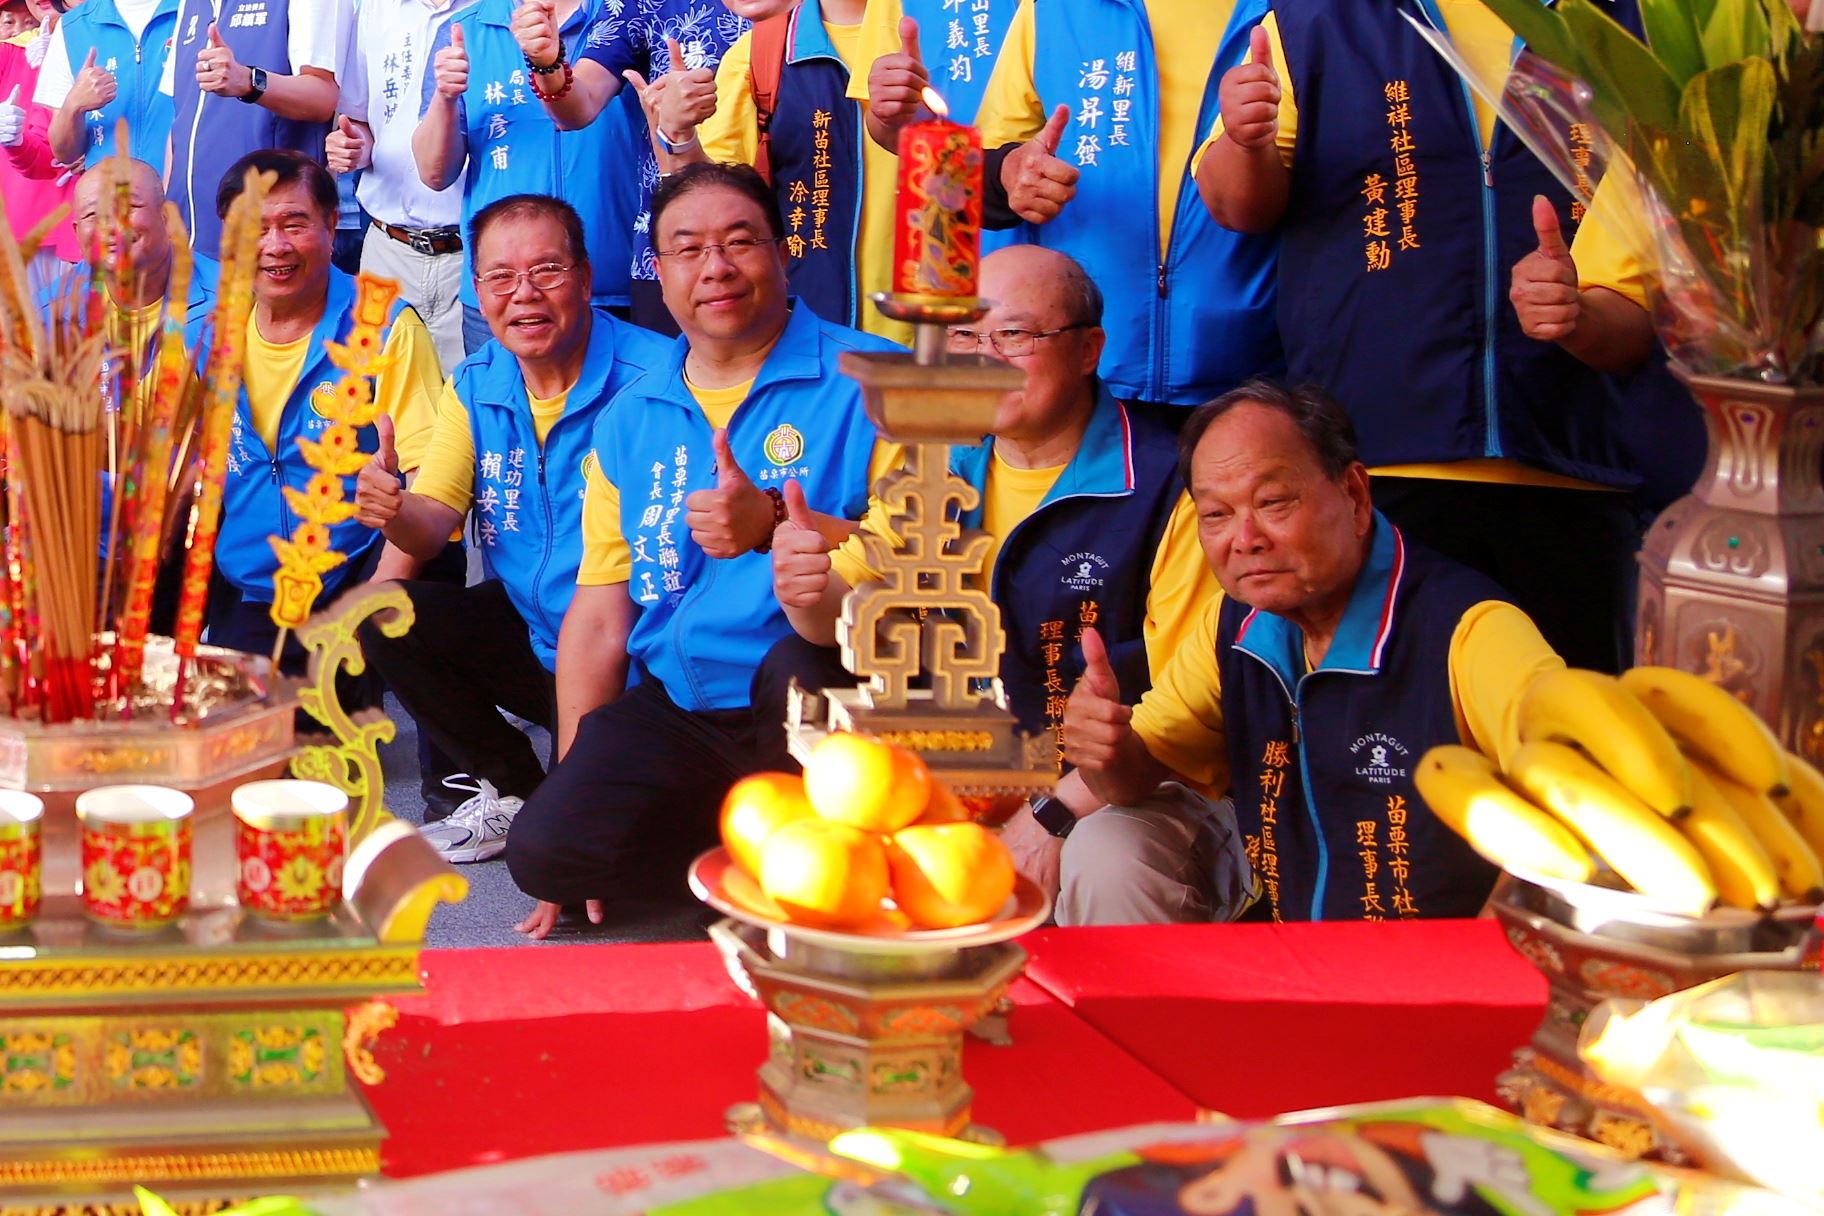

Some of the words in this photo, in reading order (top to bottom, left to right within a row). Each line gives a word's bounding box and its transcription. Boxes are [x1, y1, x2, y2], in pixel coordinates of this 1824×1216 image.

[484, 81, 510, 171] 林彥甫
[509, 69, 528, 106] 局長
[1075, 60, 1110, 168] 湯昇發
[1107, 50, 1136, 147] 維新里長
[809, 109, 833, 251] 新苗社區理事長
[1383, 80, 1422, 252] 維祥社區理事長
[1360, 175, 1392, 273] 黃建勳
[500, 446, 526, 533] 建功里長
[1060, 551, 1110, 571] MONTAGUT
[1060, 576, 1105, 587] LATITUDE
[1349, 732, 1410, 757] MONTAGUT
[1355, 767, 1406, 778] LATITUDE
[1368, 776, 1392, 785] PARIS
[1356, 820, 1386, 924] 理事長
[1386, 795, 1419, 923] 苗栗市社
